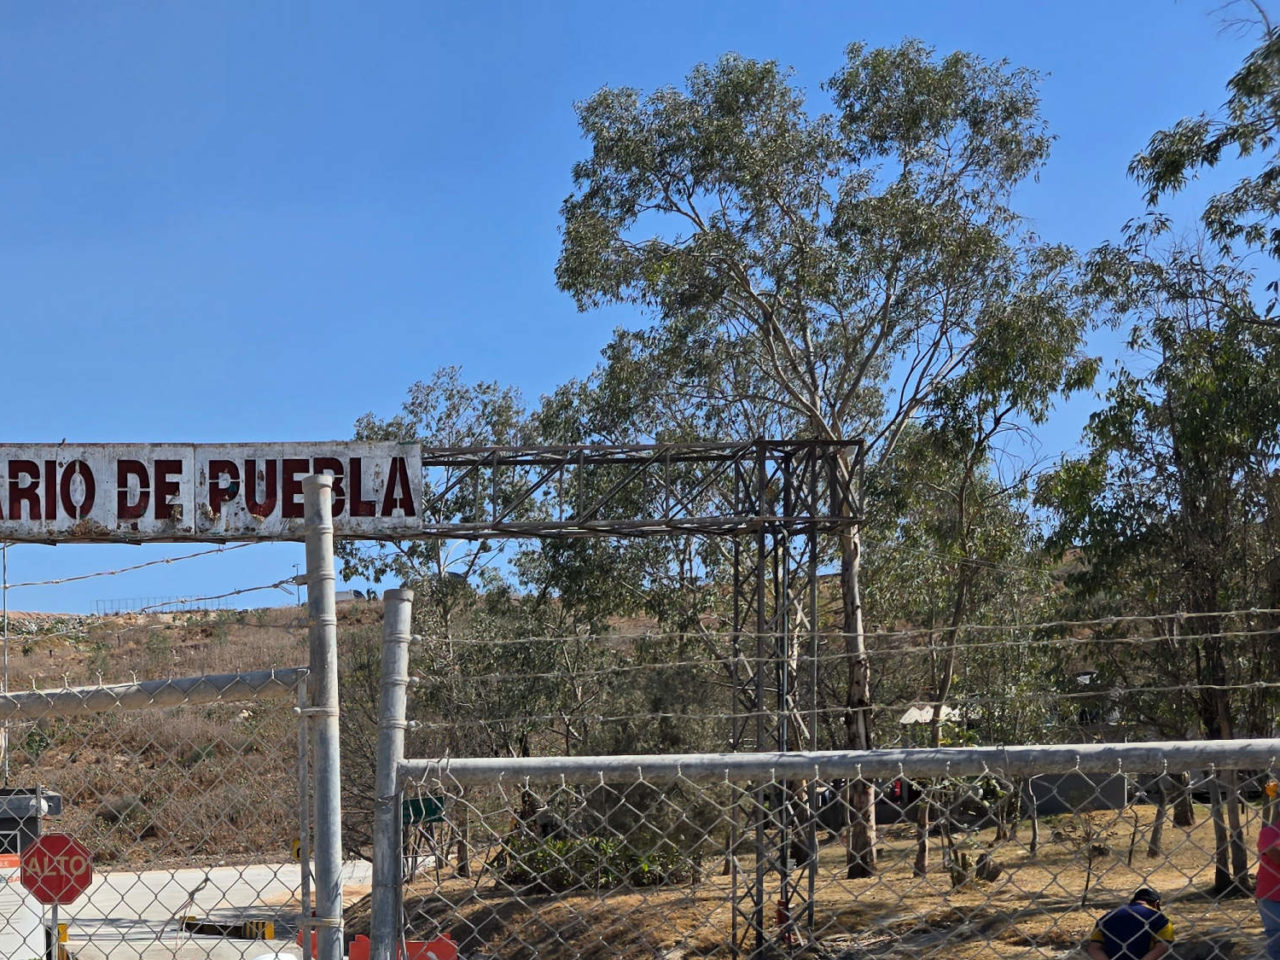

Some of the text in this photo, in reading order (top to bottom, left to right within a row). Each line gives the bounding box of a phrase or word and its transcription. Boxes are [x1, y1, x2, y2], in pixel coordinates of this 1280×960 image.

[117, 459, 184, 520] DE
[208, 456, 416, 521] PUEBLA
[25, 855, 87, 876] ALTO
